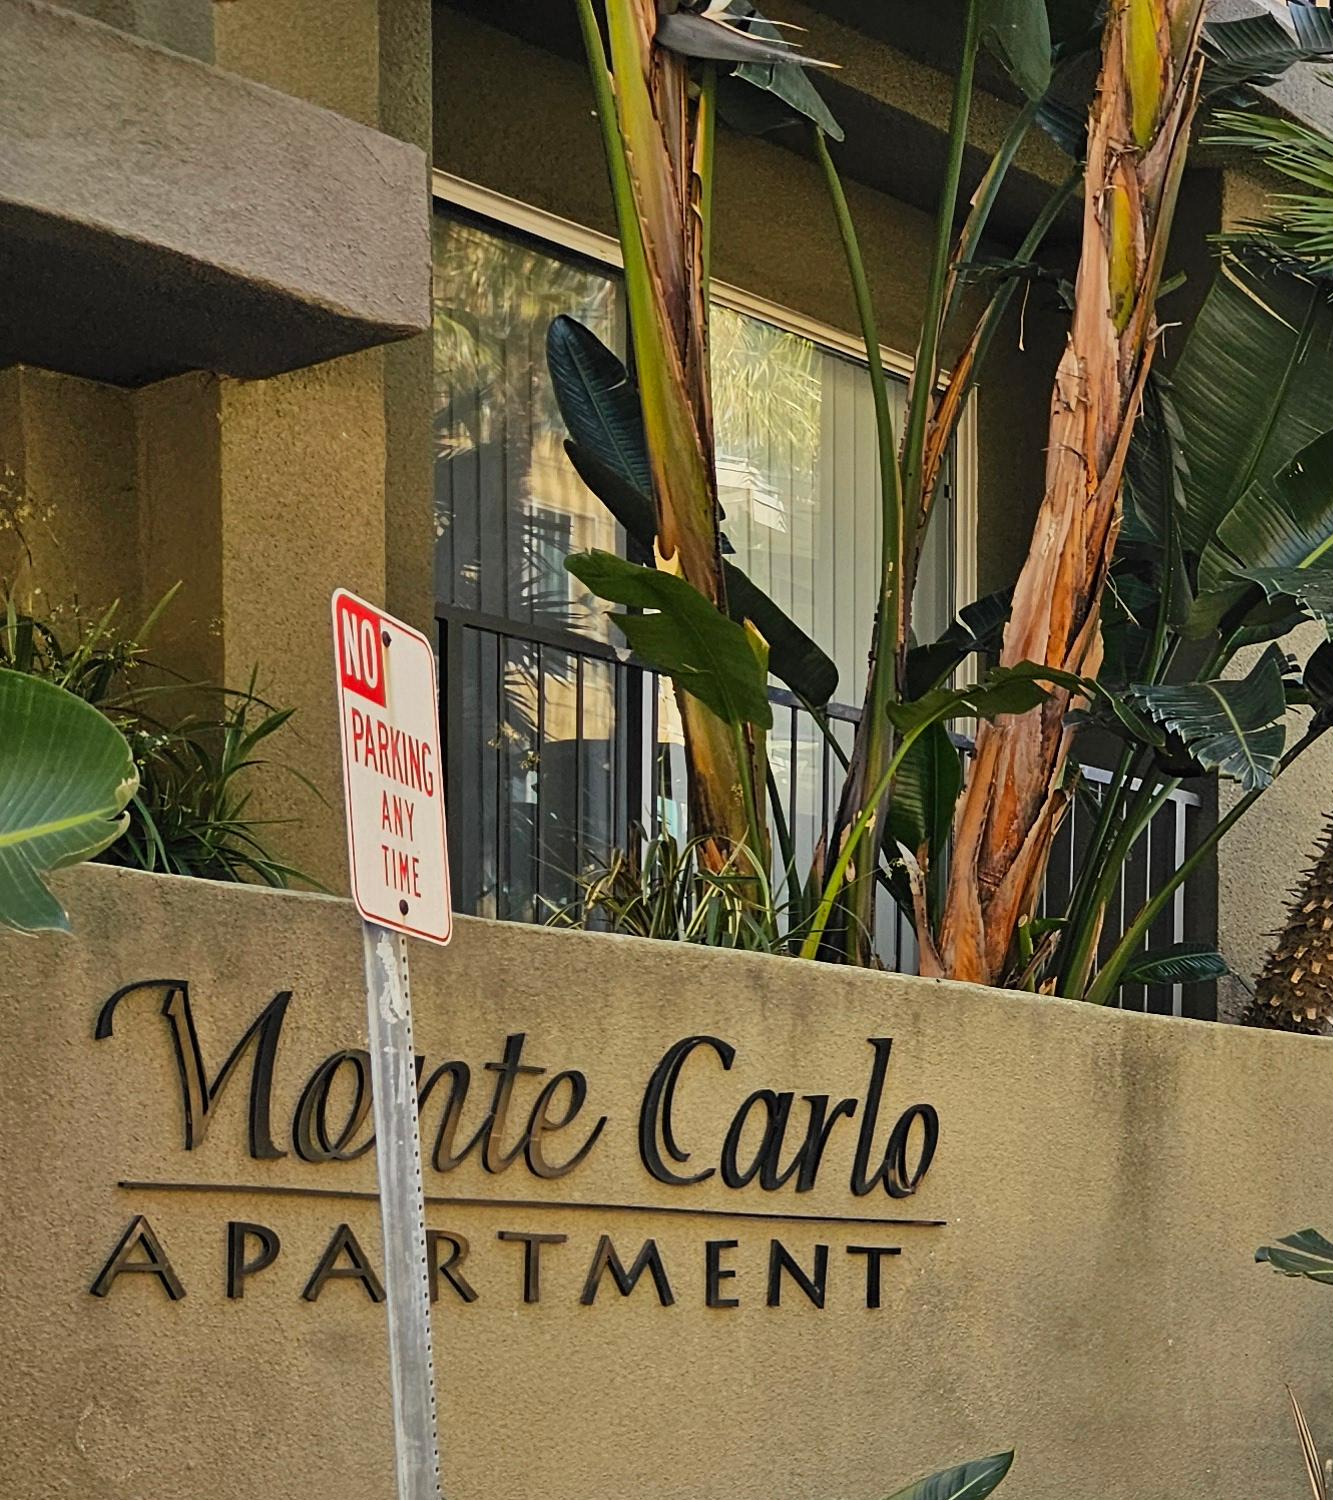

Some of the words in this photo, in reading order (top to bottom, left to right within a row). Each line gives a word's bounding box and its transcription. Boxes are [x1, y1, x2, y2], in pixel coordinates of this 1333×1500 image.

[342, 608, 378, 690] NO
[352, 707, 434, 798] PARKING
[381, 790, 415, 842] ANY
[381, 844, 422, 899] TIME
[94, 979, 608, 1179] Monte
[638, 1034, 940, 1200] Carlo
[89, 1213, 903, 1310] APARTMENT
